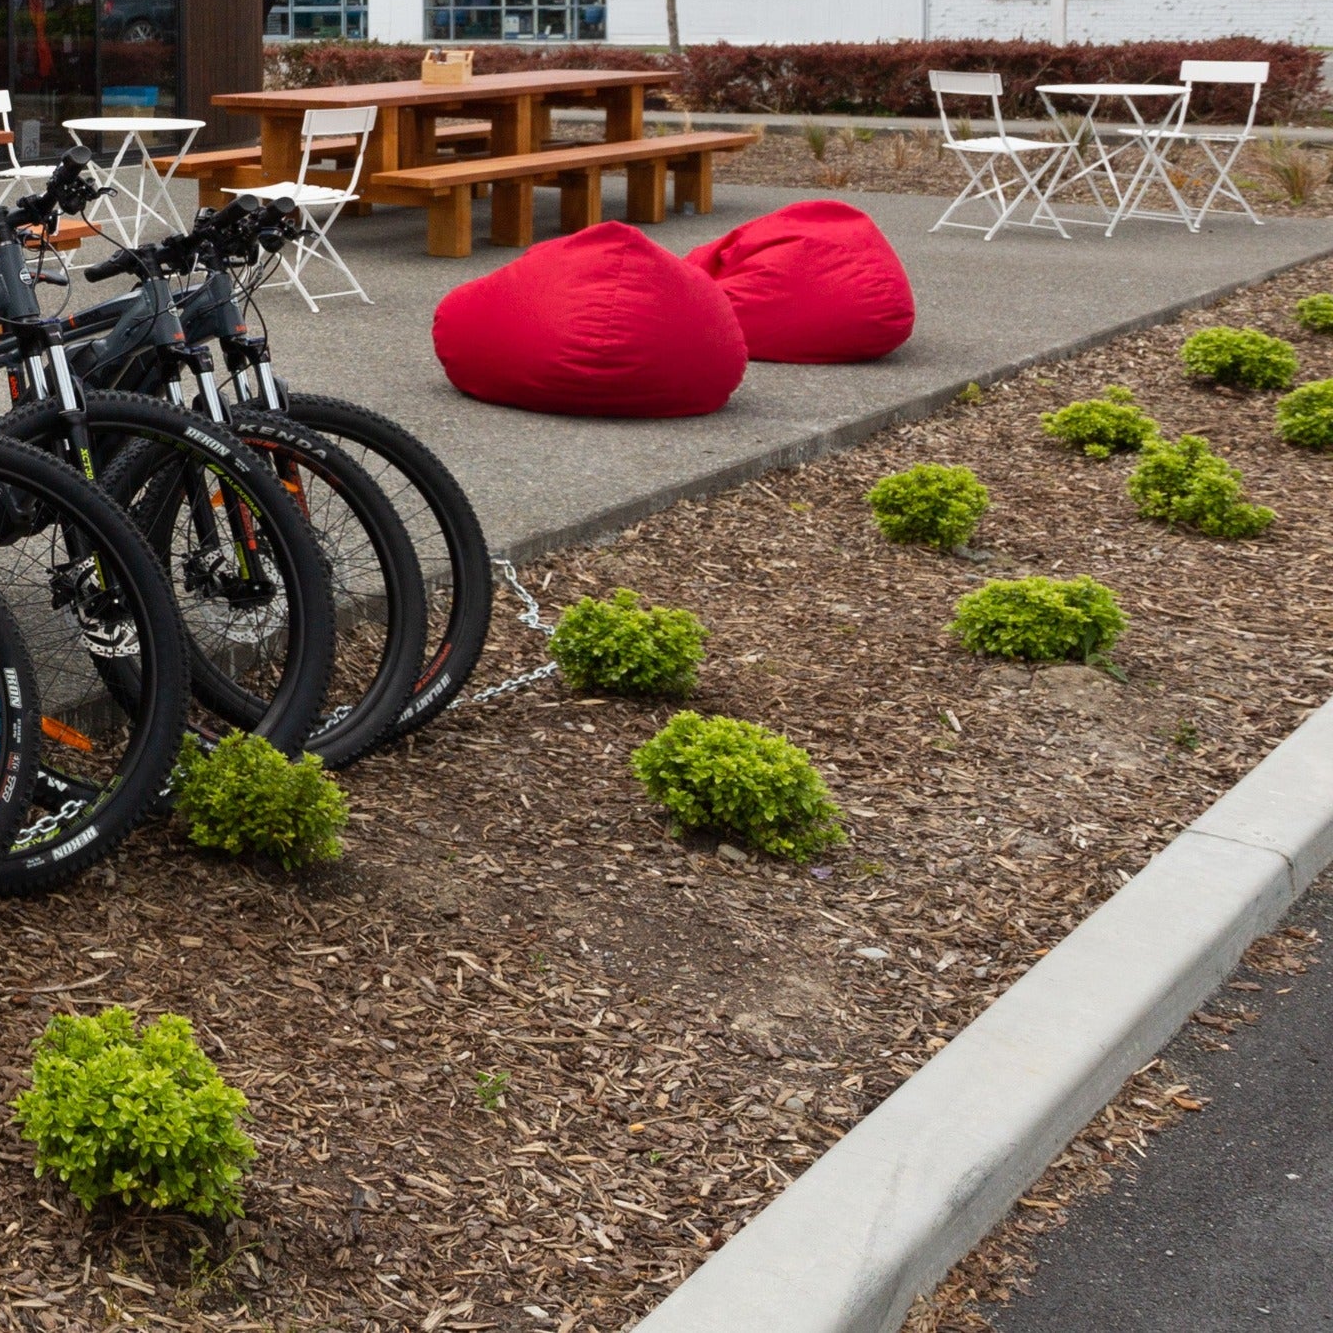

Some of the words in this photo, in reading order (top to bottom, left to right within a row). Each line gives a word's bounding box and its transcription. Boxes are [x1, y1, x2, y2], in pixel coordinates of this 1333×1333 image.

[183, 425, 232, 458] REKON
[236, 422, 329, 461] KENDA
[52, 824, 101, 862] REKON
